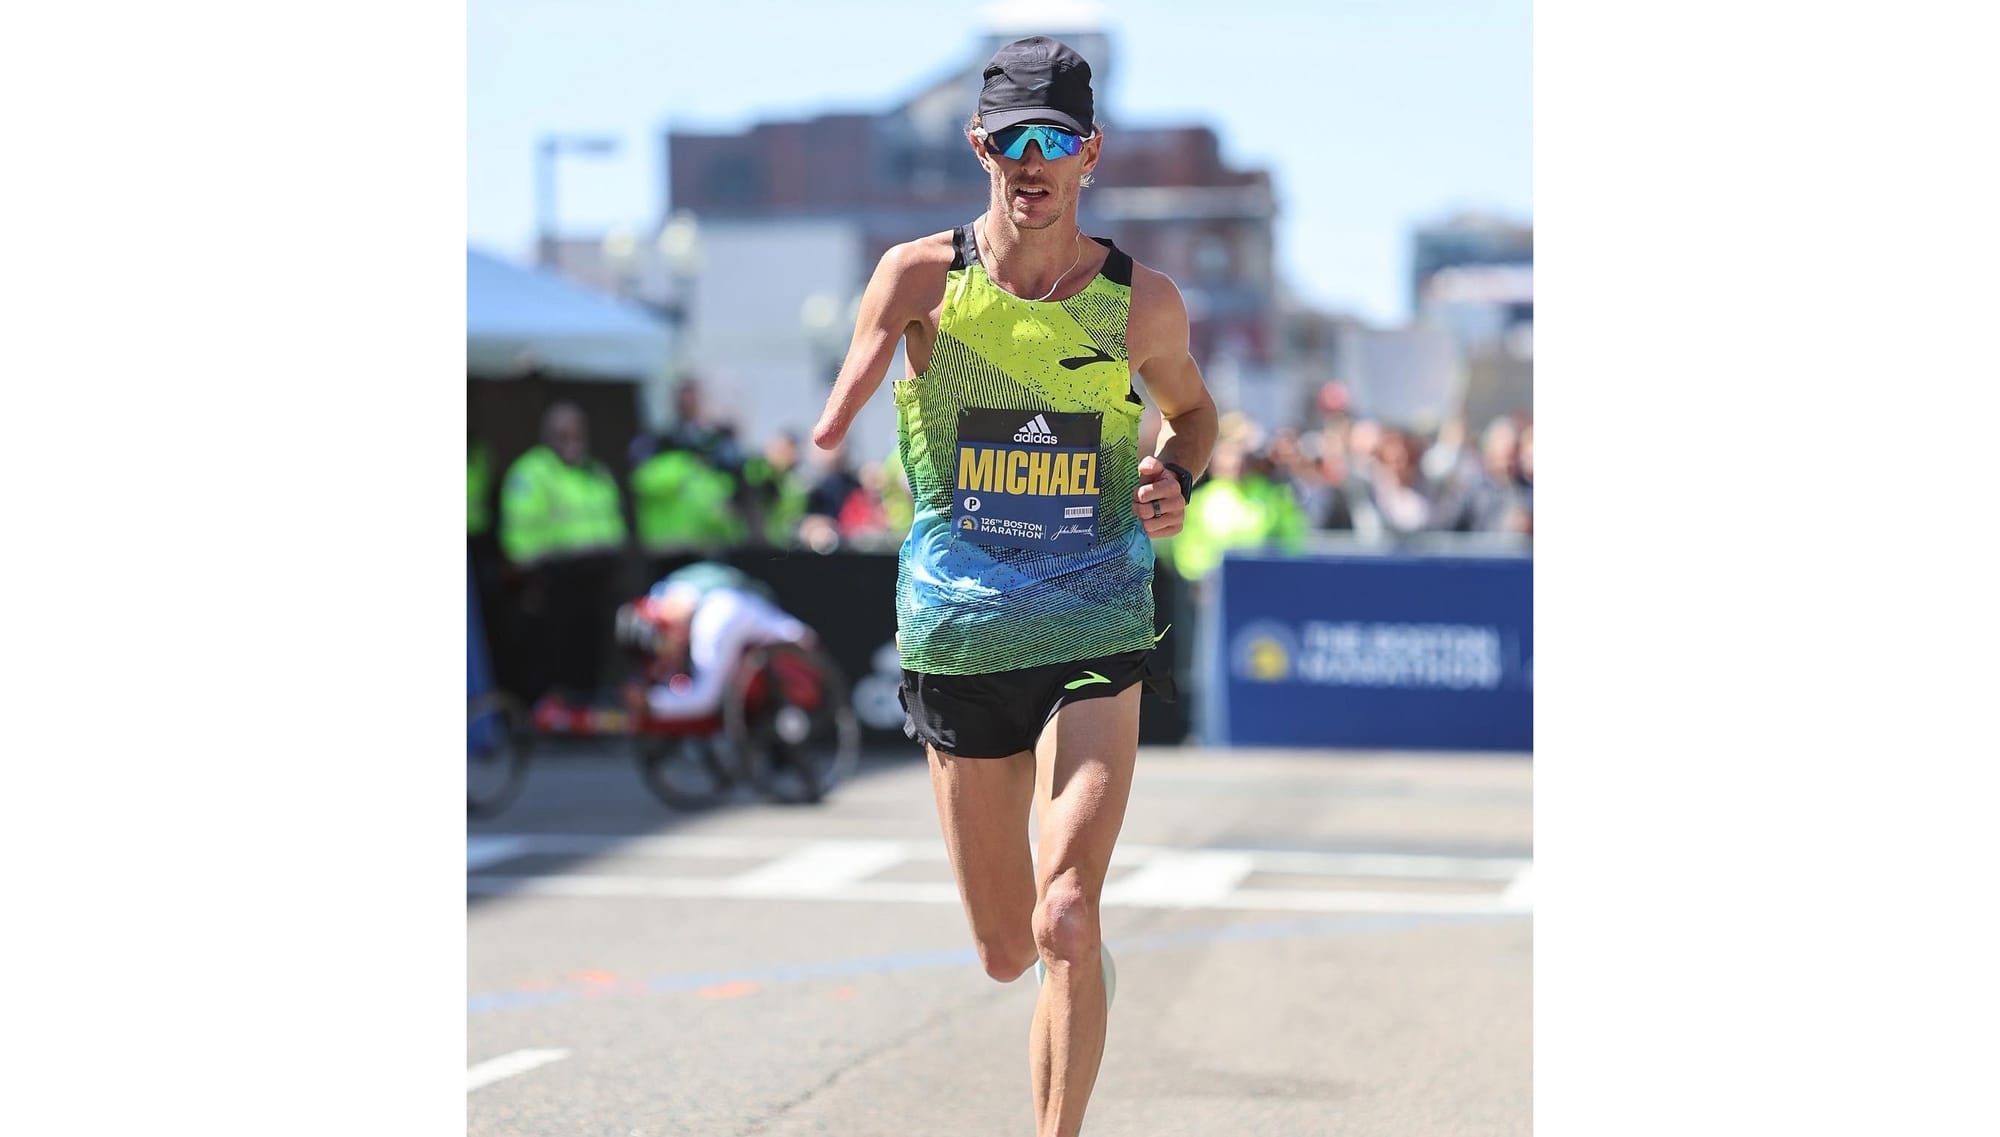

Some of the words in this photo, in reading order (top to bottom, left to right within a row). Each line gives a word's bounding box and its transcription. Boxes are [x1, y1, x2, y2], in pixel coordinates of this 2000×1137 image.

[1013, 432, 1058, 445] adidas
[958, 447, 1100, 496] MICHAEL
[980, 525, 1042, 540] MARATHON
[1003, 519, 1043, 532] BOSTON
